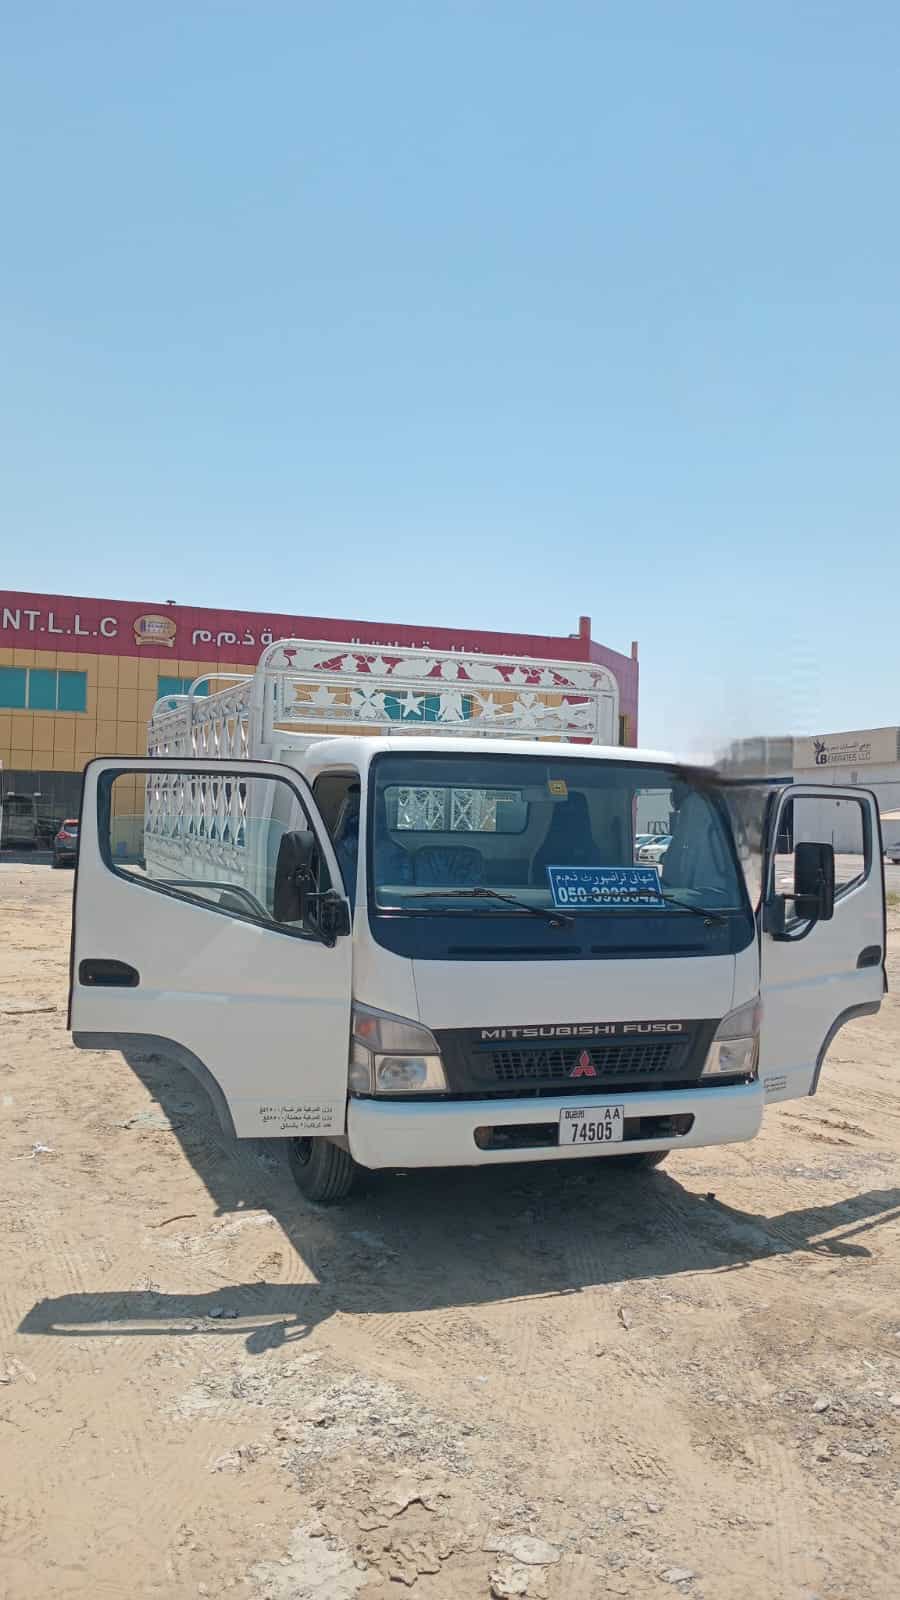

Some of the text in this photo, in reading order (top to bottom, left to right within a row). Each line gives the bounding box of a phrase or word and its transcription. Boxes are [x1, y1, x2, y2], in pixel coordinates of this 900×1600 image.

[481, 1023, 682, 1040] MITSUBISHI FUSO
[604, 1107, 620, 1120] AA
[571, 1122, 612, 1142] 74505
